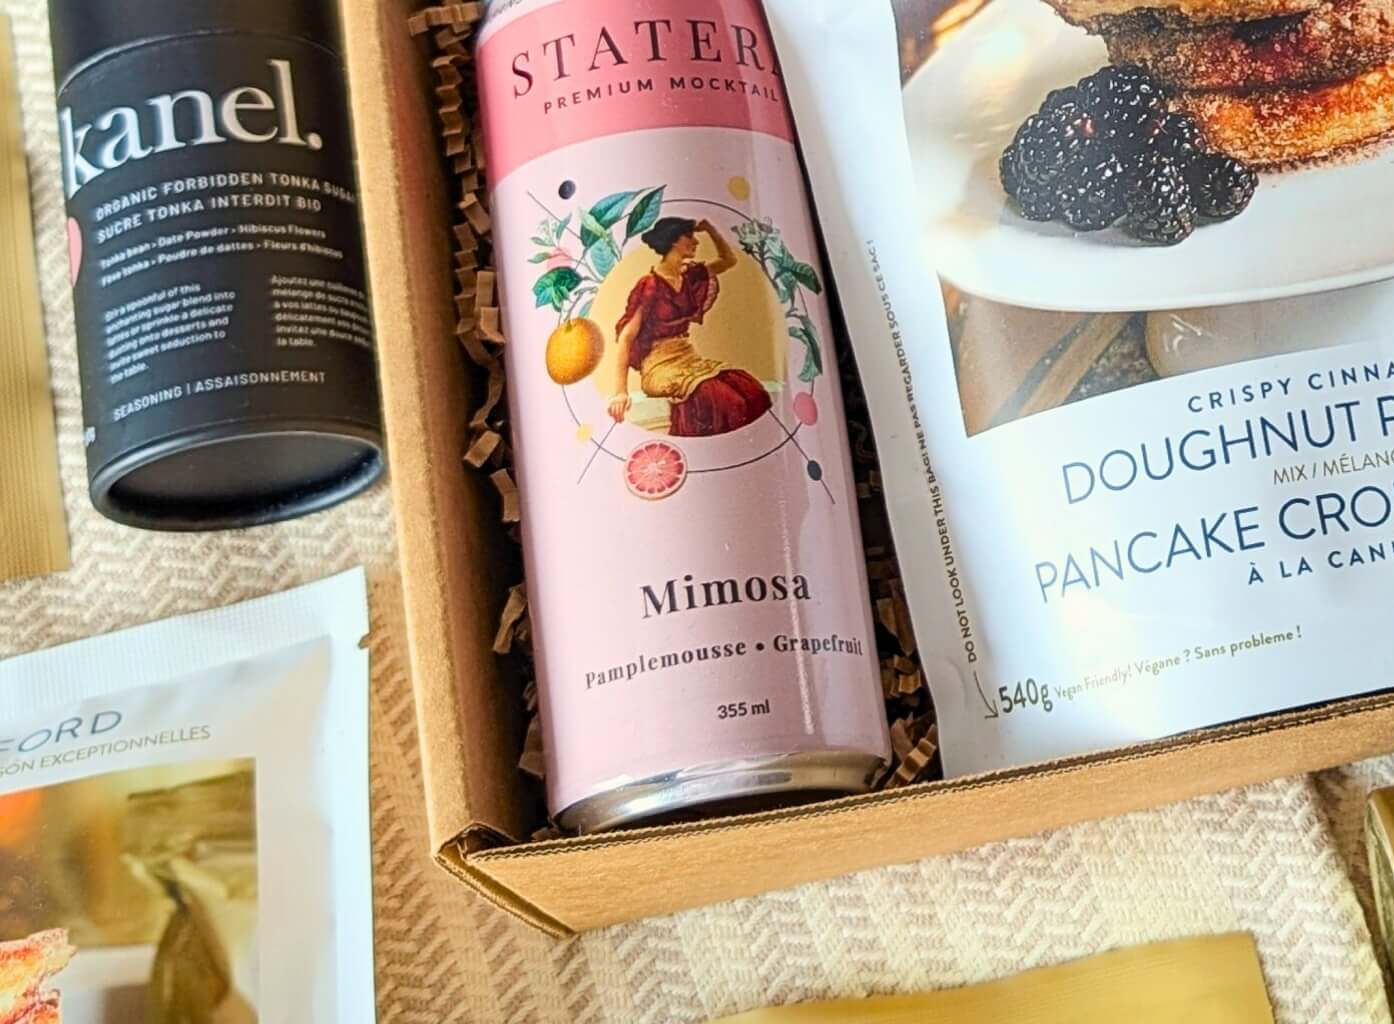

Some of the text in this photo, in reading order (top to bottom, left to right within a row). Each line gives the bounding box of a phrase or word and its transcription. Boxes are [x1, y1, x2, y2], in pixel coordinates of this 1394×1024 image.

[543, 77, 780, 114] PREMIUM MOCKTAIL
[58, 59, 323, 201] kanel.
[96, 172, 321, 222] ORGANIC FORBIDDEN TONKA
[97, 194, 292, 244] SUCRE TONKA INTERDIT
[157, 240, 254, 264] Poudre dattes
[158, 226, 229, 248] Date Powder
[113, 370, 326, 422] SEASONING ASSAISONNEMENT
[1187, 378, 1292, 413] CRISPY
[1062, 400, 1361, 505] DOUGHNUT
[881, 294, 977, 664] DO NOT LOOK UNDER THIS REGARDER SOUS
[1034, 505, 1265, 604] PANCAKE
[1248, 562, 1264, 586] À
[1279, 556, 1313, 579] LA
[640, 573, 811, 619] Mimosa
[585, 634, 864, 690] Pamplemousse Grapefruit
[998, 644, 1227, 714] 540g Vegan Friendly! Sans
[717, 699, 771, 719] 355 ml
[40, 725, 211, 769] EXCEPTIONNELLES
